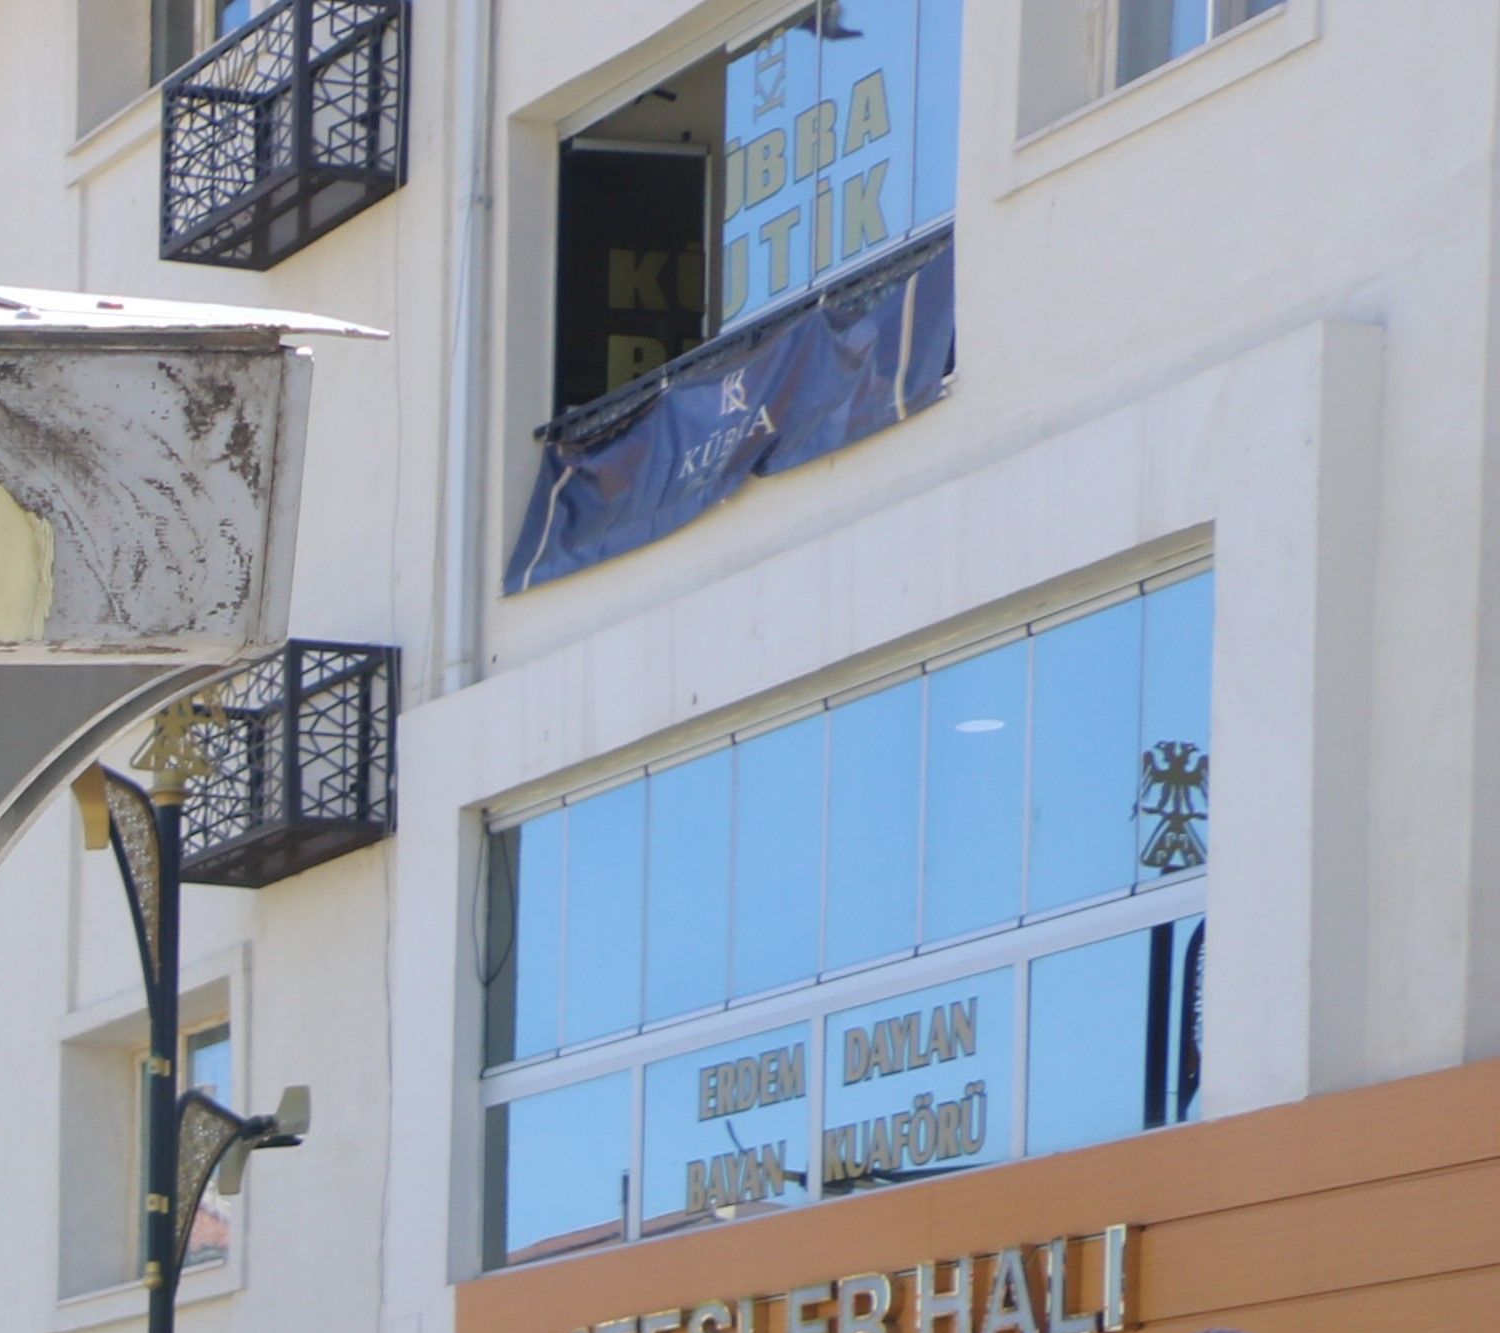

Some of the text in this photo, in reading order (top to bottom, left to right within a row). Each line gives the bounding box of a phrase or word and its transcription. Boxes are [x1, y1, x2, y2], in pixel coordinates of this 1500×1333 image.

[677, 404, 777, 479] KÜBA
[698, 996, 979, 1123] ERDEM DAYLAN
[685, 1079, 988, 1216] BAYAN KUAFÖRÜ
